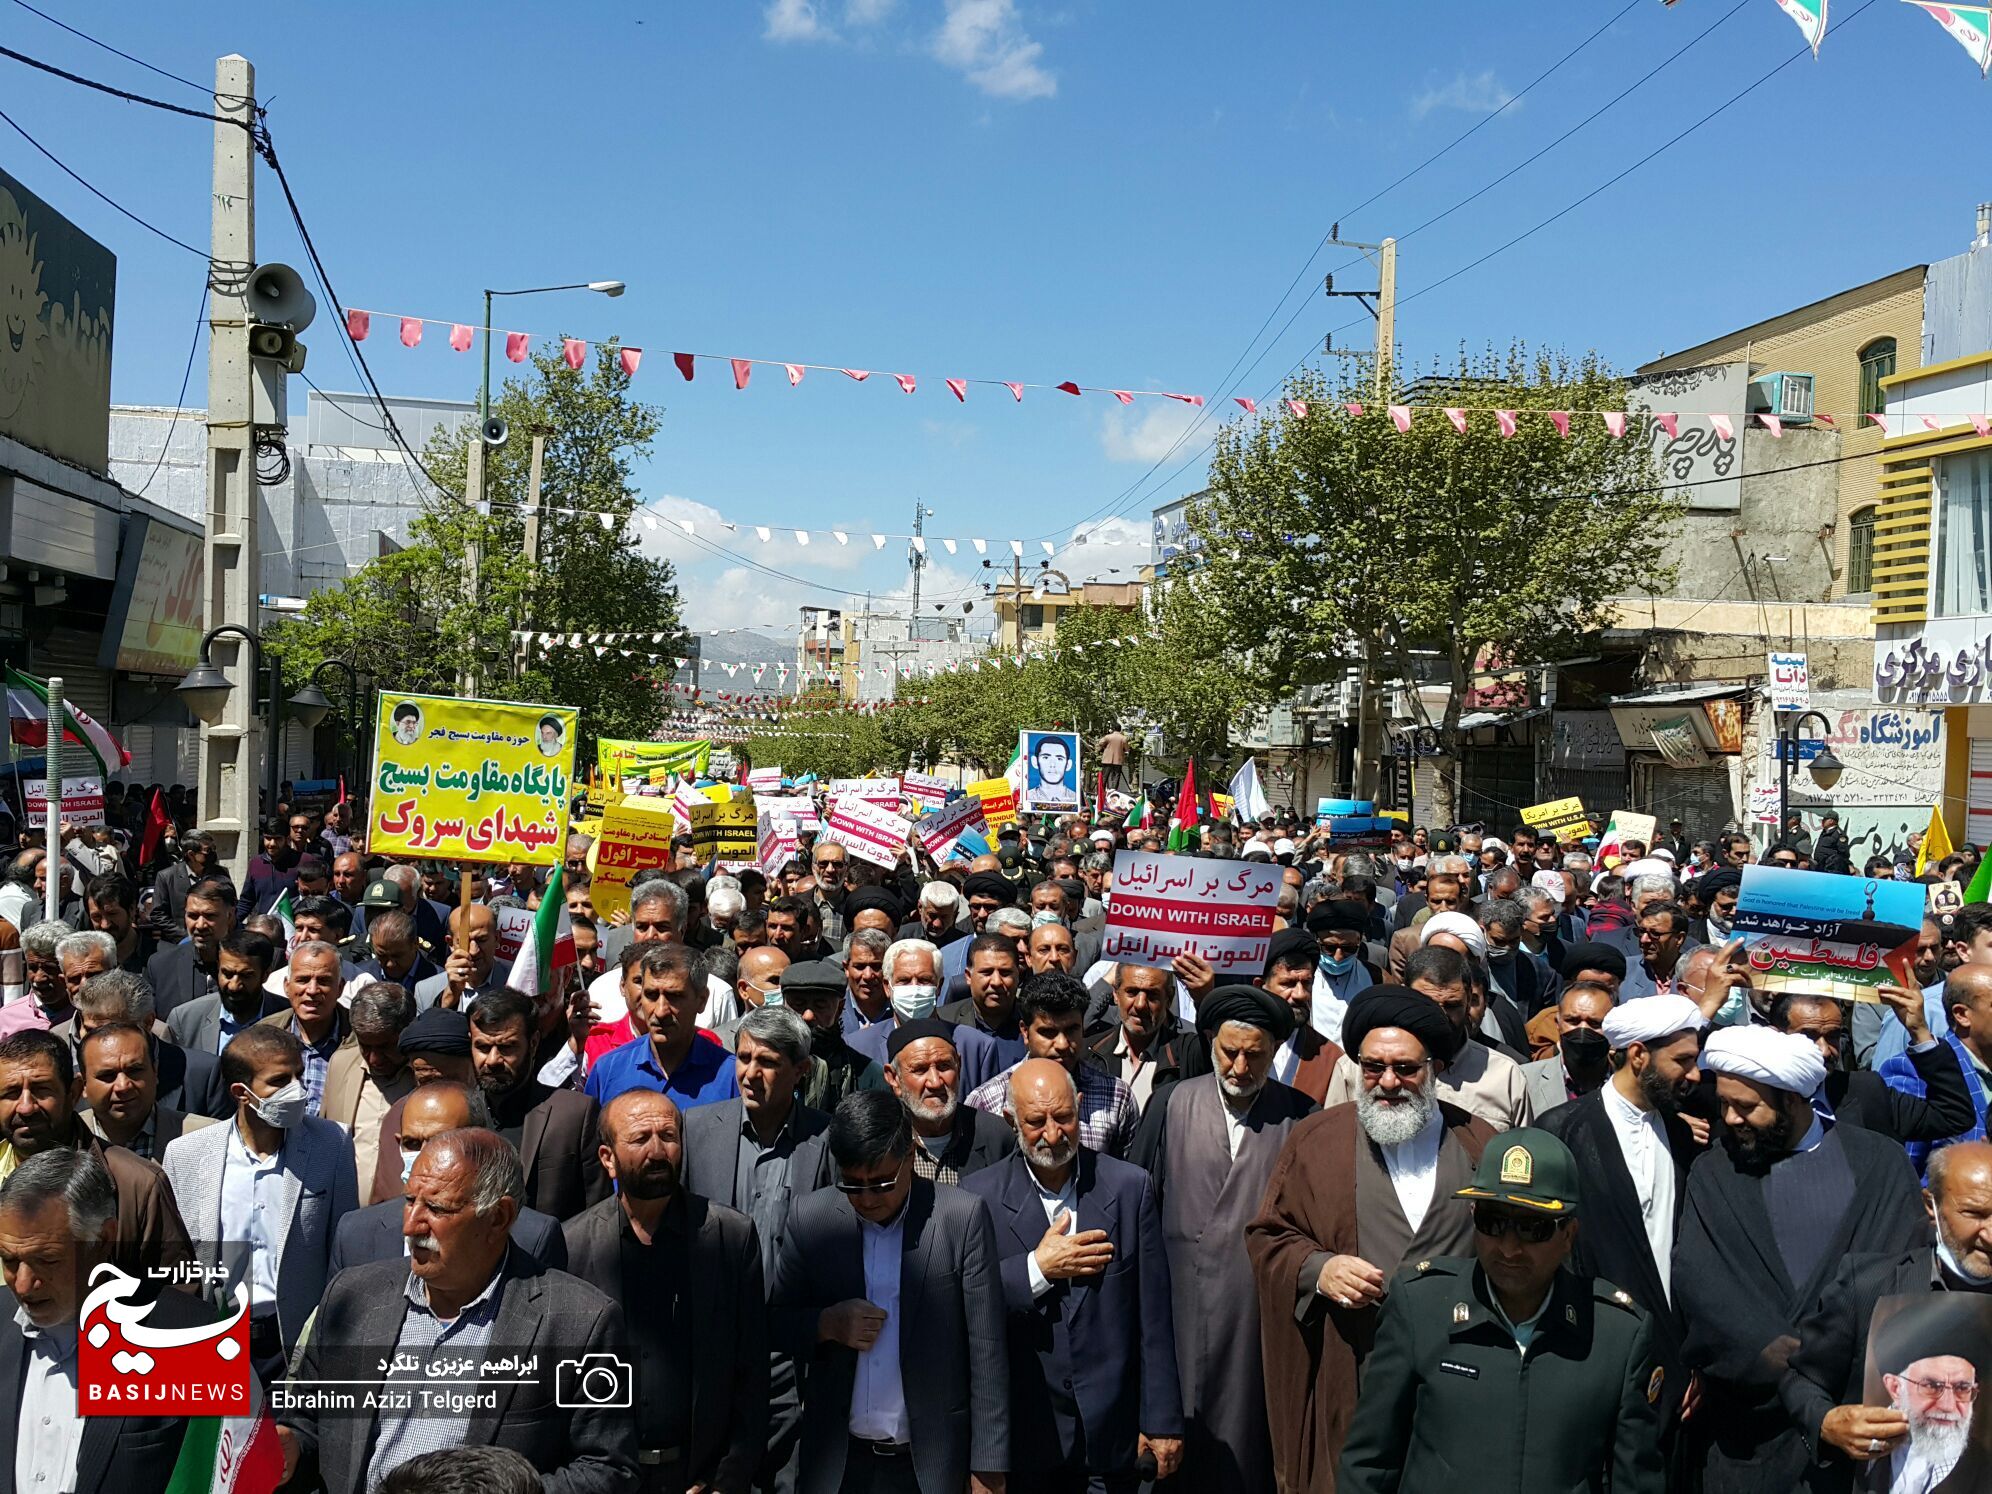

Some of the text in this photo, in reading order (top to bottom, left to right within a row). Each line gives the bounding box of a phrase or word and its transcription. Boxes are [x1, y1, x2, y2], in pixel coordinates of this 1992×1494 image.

[1771, 654, 1805, 669] بیمه
[1876, 633, 1992, 687] ازی مرکزی
[1775, 668, 1806, 683] دانا
[428, 726, 530, 746] حوزه مقاومت بسیج فجر
[1860, 709, 1944, 750] آموزشگاه
[76, 780, 99, 794] مرگ
[378, 758, 567, 809] پایگاه مقاومت بسیج
[831, 782, 897, 797] مرگ بر اسرائیل
[63, 788, 73, 796] بر
[590, 793, 616, 805] اسرائیل
[838, 803, 873, 817] اسرائیل
[959, 800, 978, 812] مرگ
[1563, 802, 1580, 812] مرگ
[72, 811, 103, 824] الموت
[690, 807, 754, 825] مرگ بر اسرائیل
[986, 813, 1015, 824] STANDUP
[380, 799, 560, 852] شهدای سروک
[831, 816, 855, 830] DOWN
[855, 823, 875, 837] WITH
[886, 819, 906, 833] مرگ
[921, 813, 947, 837] اسرائیل
[1532, 822, 1548, 830] OWN
[1549, 818, 1566, 828] WITH
[603, 826, 631, 839] مقاومت
[635, 831, 671, 845] ایستادگی
[704, 829, 722, 838] WITH
[724, 829, 755, 838] ISRAEL
[825, 831, 897, 864] الموت لاسرائیل
[926, 835, 944, 850] DOWN
[600, 844, 632, 865] افول
[720, 845, 755, 859] الموت
[1118, 862, 1274, 899] مرگ بر اسرائیل
[1109, 902, 1271, 928] DOWN WITH ISRAEL
[1761, 899, 1786, 907] honored
[1787, 901, 1799, 909] that
[1799, 903, 1825, 912] Palestine
[1844, 908, 1861, 916] freed
[1762, 918, 1810, 933] خواهد
[1813, 923, 1842, 937] آزاد
[1202, 943, 1267, 968] الموت
[1750, 936, 1880, 971] فلسطین
[1787, 966, 1797, 975] که
[1800, 968, 1819, 978] است
